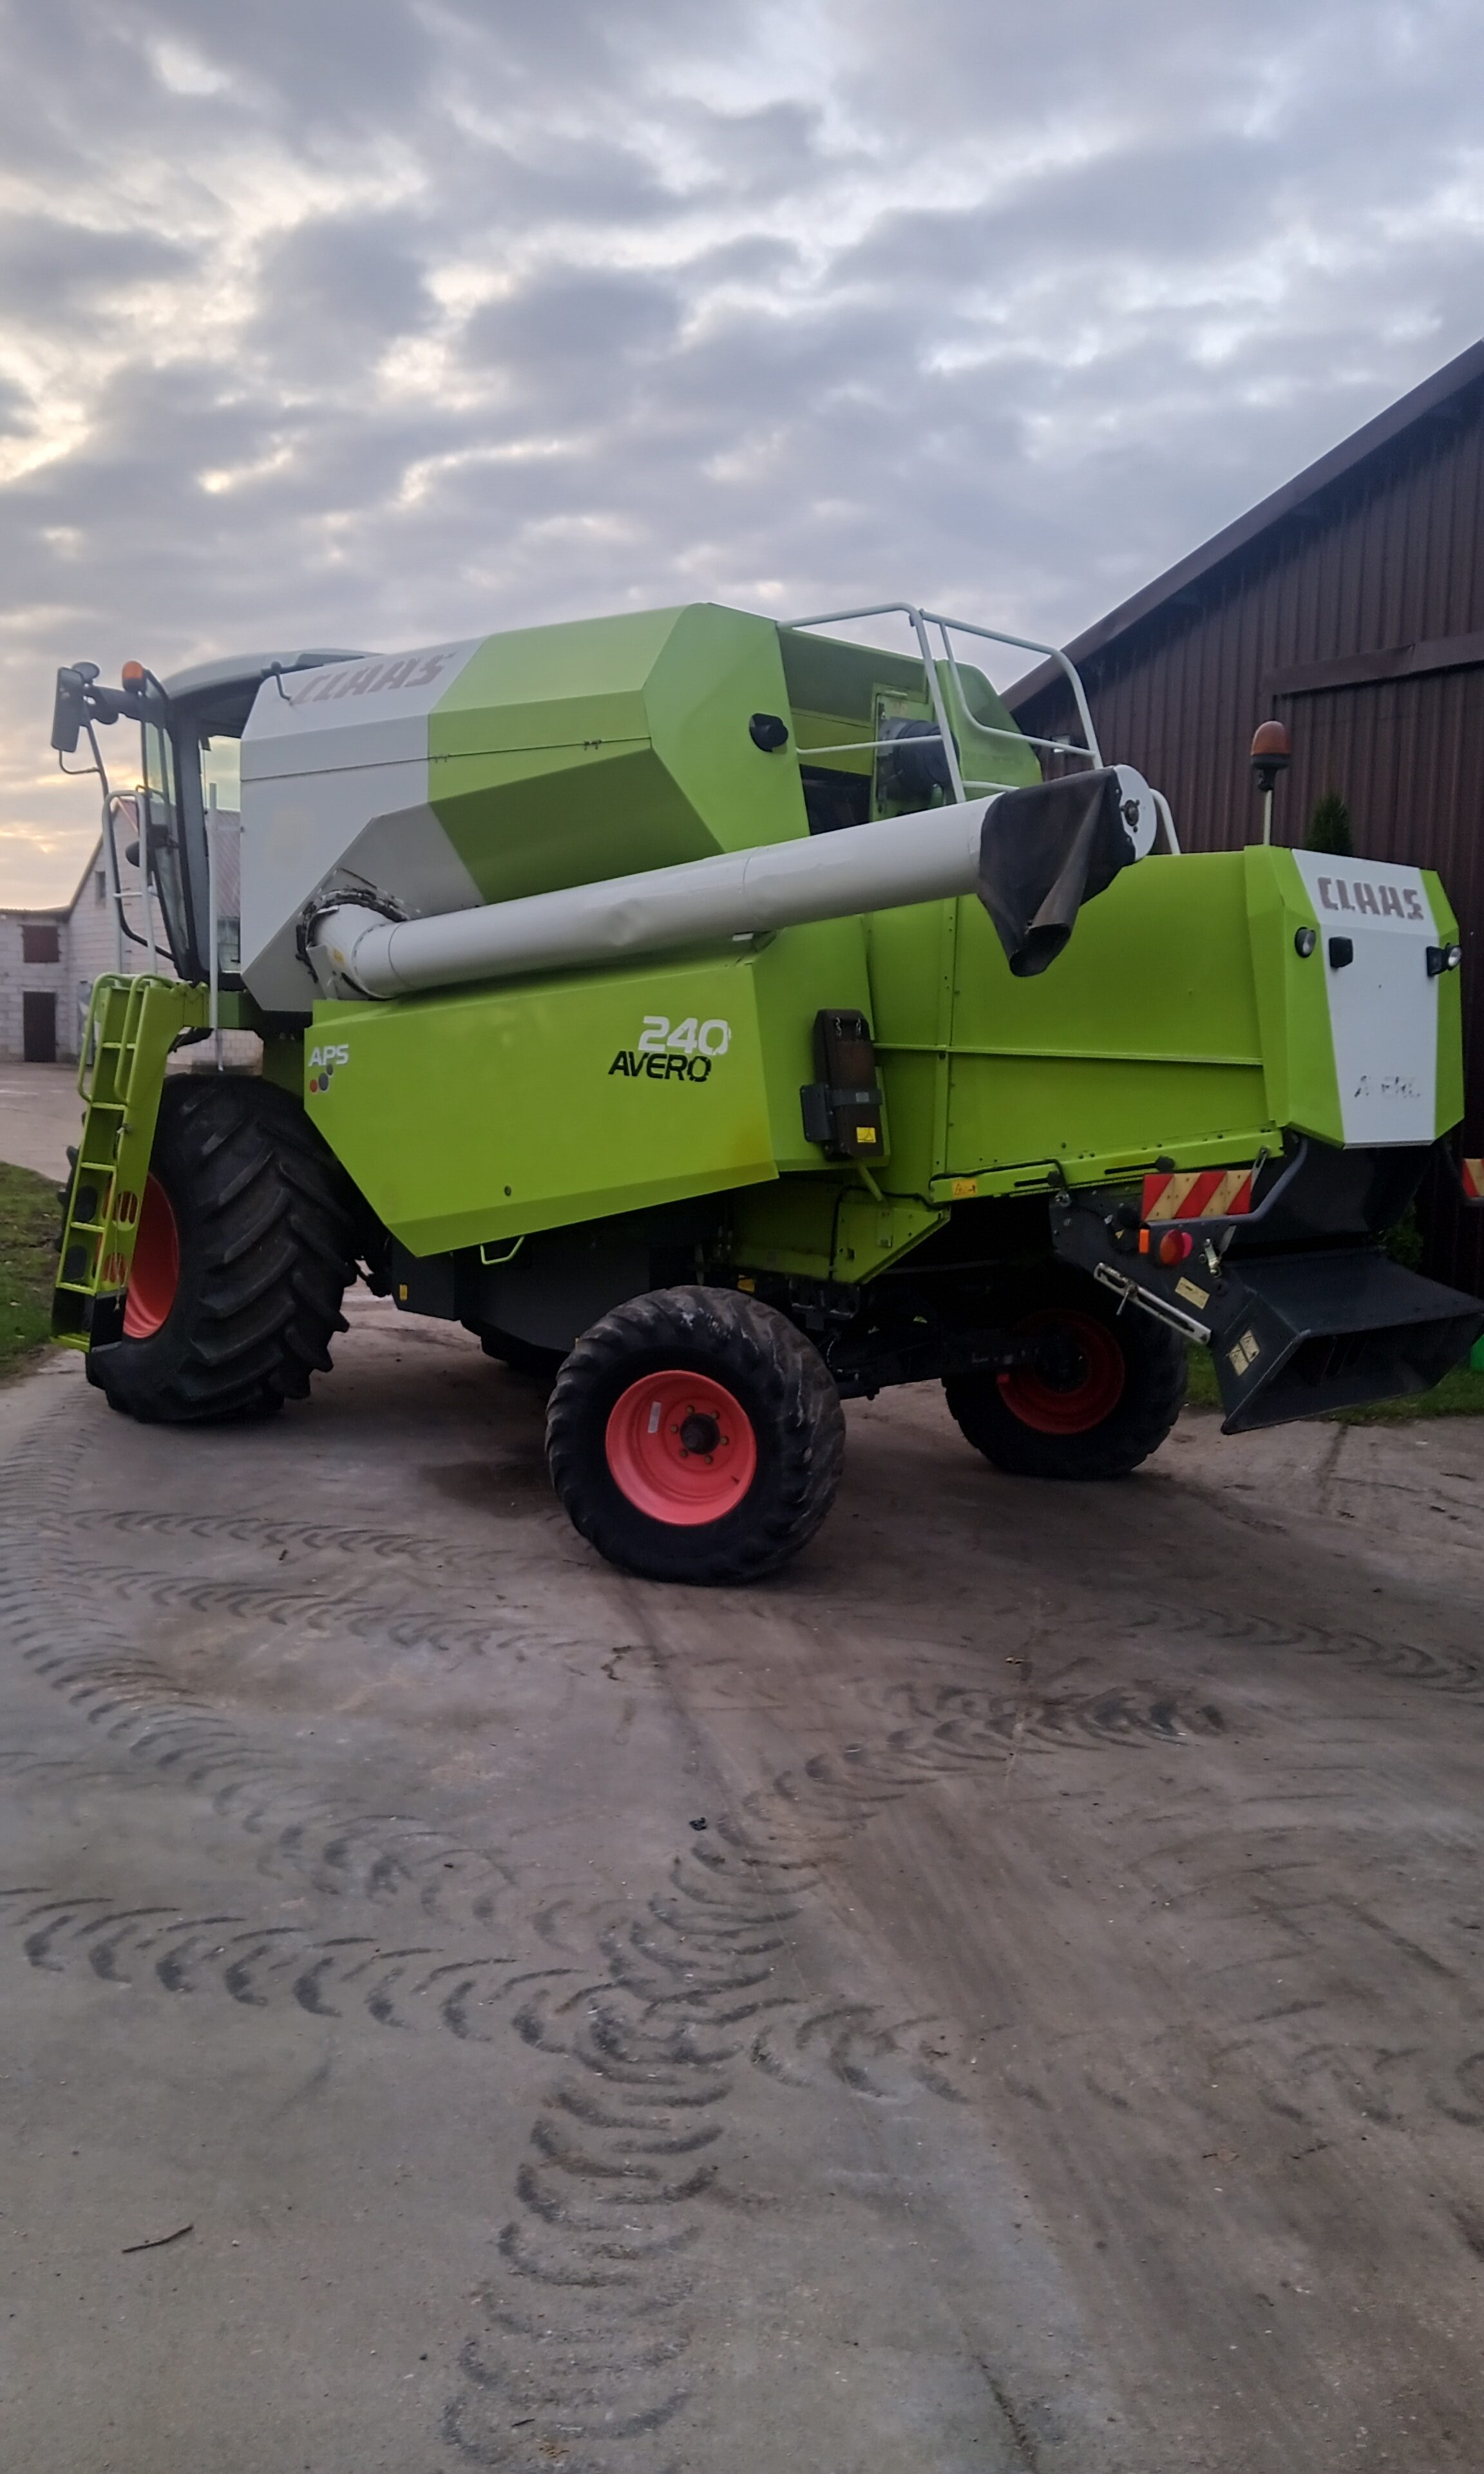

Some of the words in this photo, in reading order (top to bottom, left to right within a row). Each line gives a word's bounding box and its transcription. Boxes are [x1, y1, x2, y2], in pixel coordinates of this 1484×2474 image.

[290, 652, 457, 704] CLAAS
[1318, 877, 1423, 920] CLAAS
[308, 1044, 349, 1066] APS
[638, 1015, 732, 1055] 240
[608, 1050, 712, 1082] AVERO
